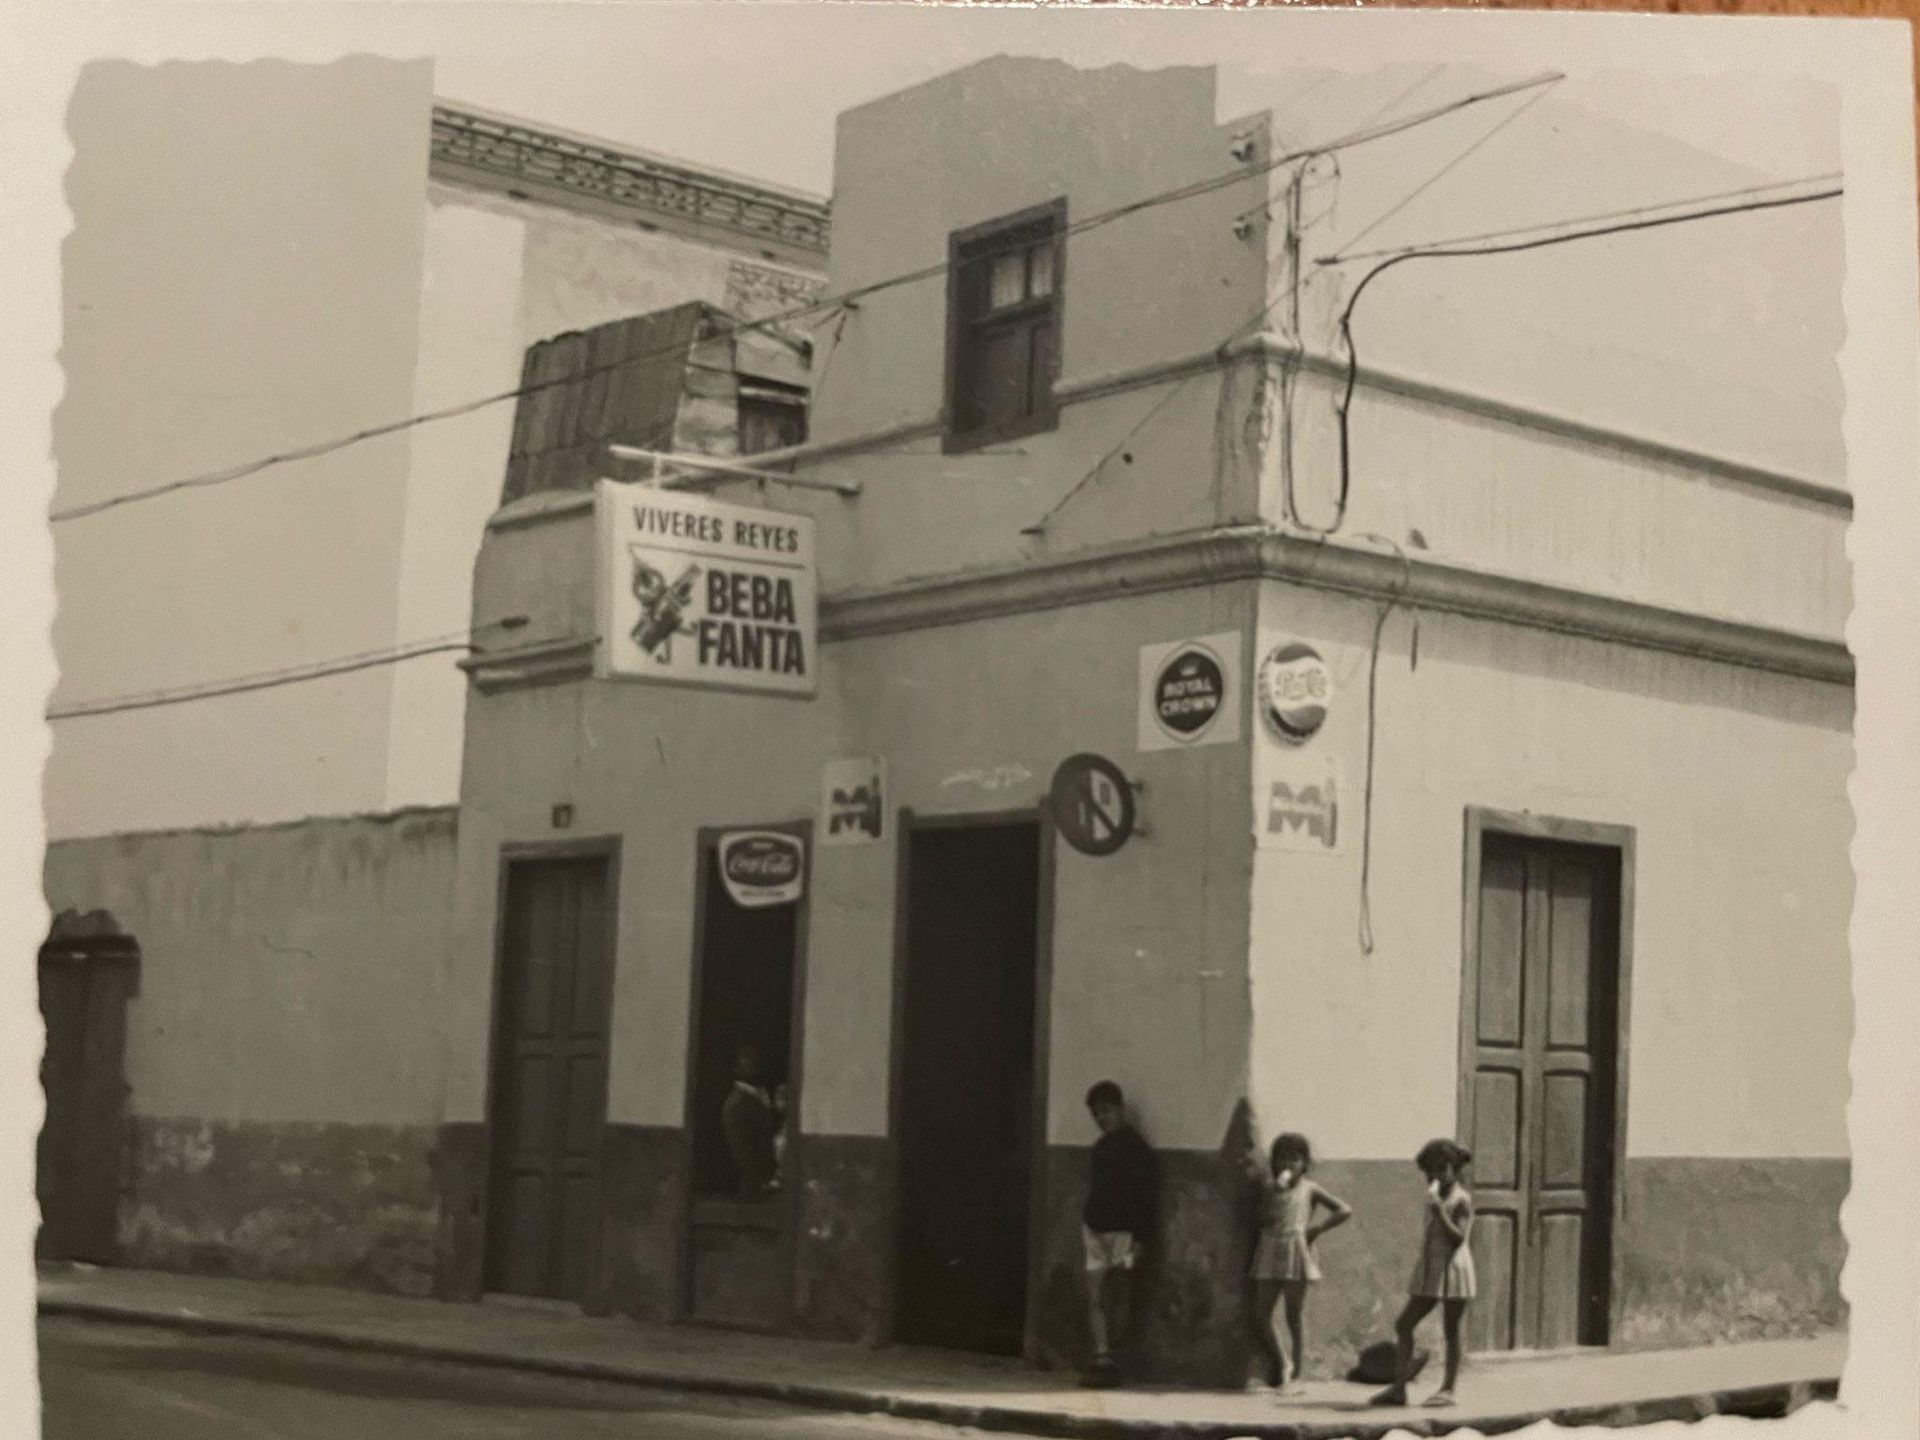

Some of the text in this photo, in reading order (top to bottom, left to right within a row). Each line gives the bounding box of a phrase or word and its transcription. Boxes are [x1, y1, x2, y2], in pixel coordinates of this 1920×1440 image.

[633, 506, 799, 553] VIVERES REYES
[707, 569, 796, 625] BEBA
[698, 618, 806, 676] FANTA
